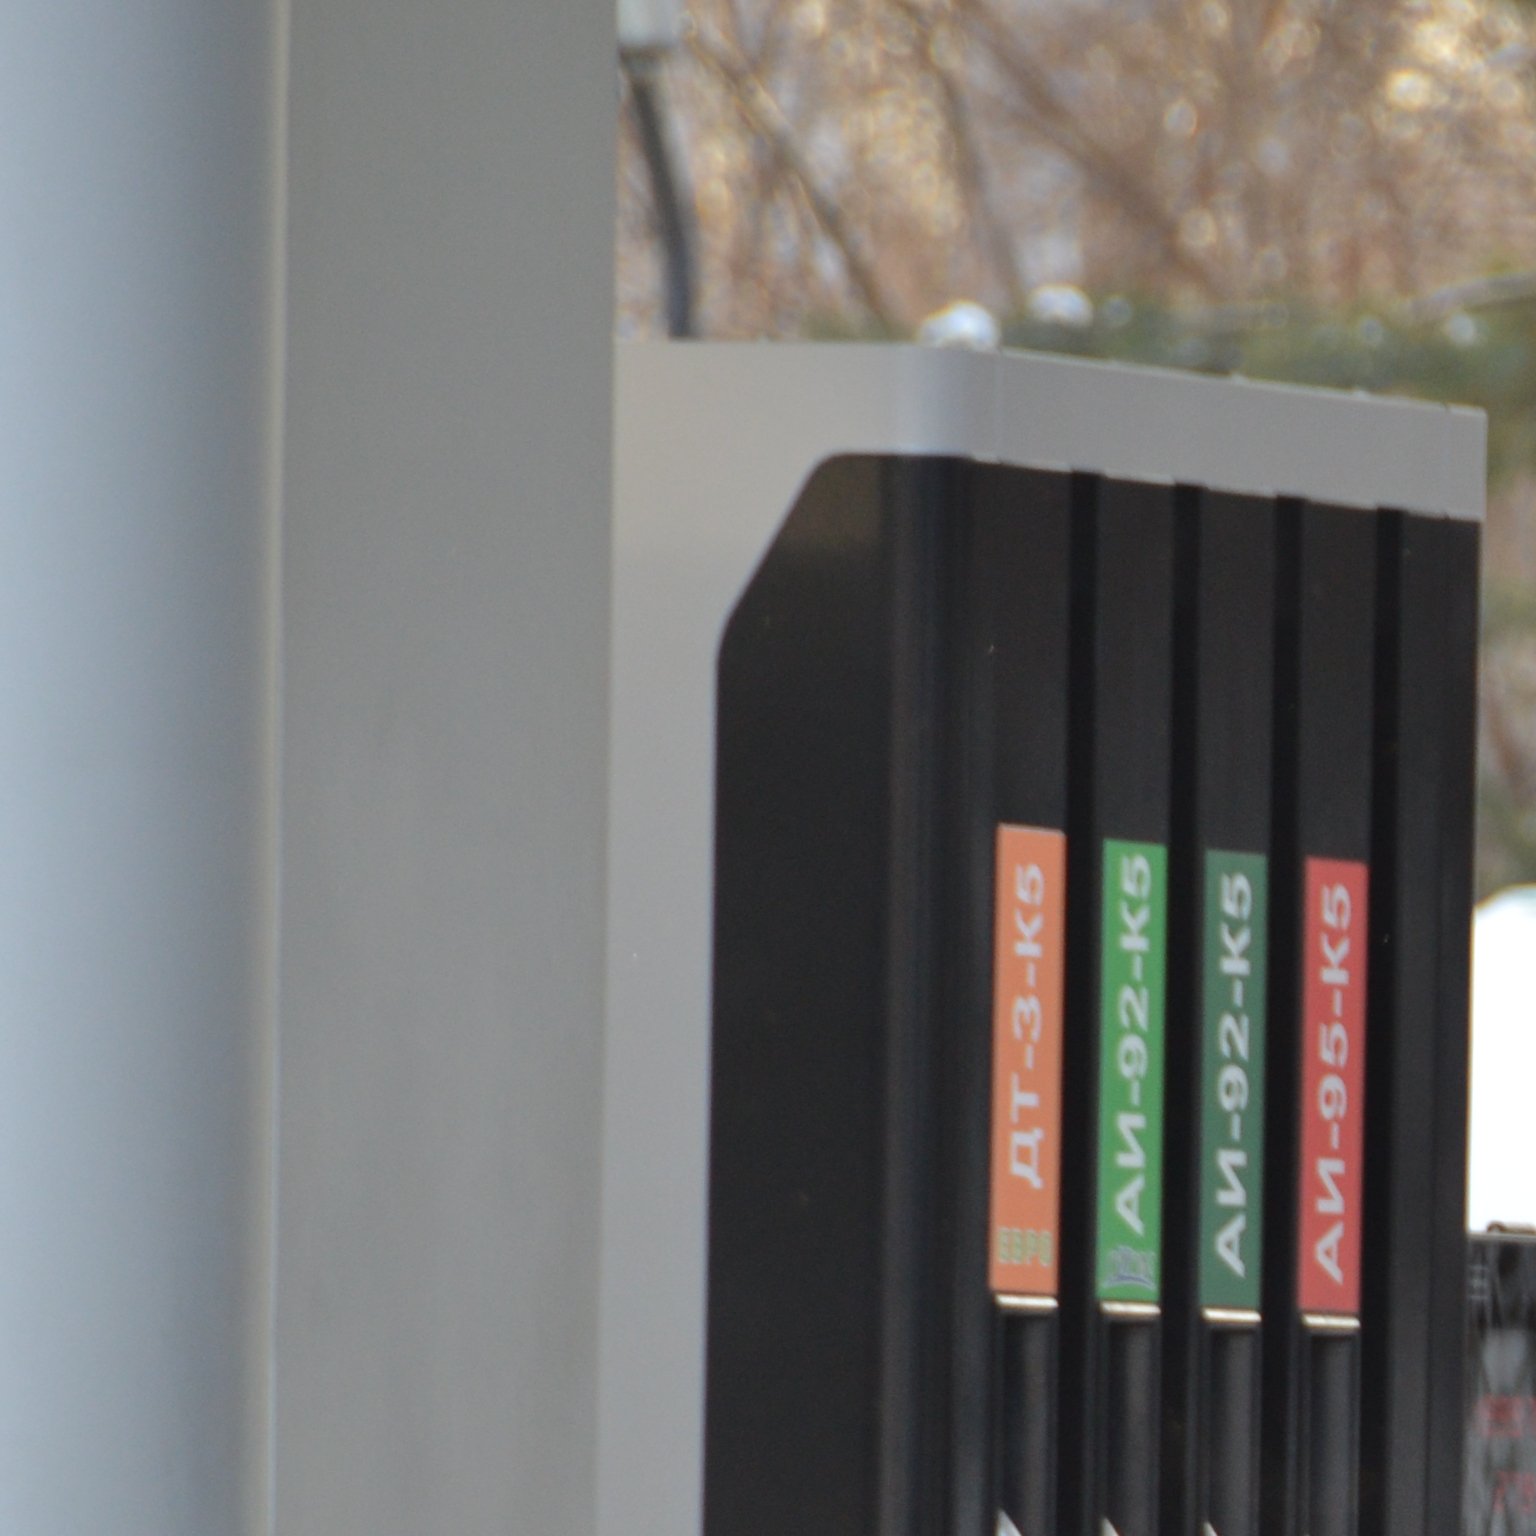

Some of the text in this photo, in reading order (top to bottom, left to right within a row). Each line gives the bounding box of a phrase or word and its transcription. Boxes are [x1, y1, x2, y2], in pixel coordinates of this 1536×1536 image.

[1115, 854, 1152, 1236] АИ-92-К5
[1216, 873, 1253, 1278] АИ-92-К5
[1315, 884, 1353, 1285] АИ-95-К5
